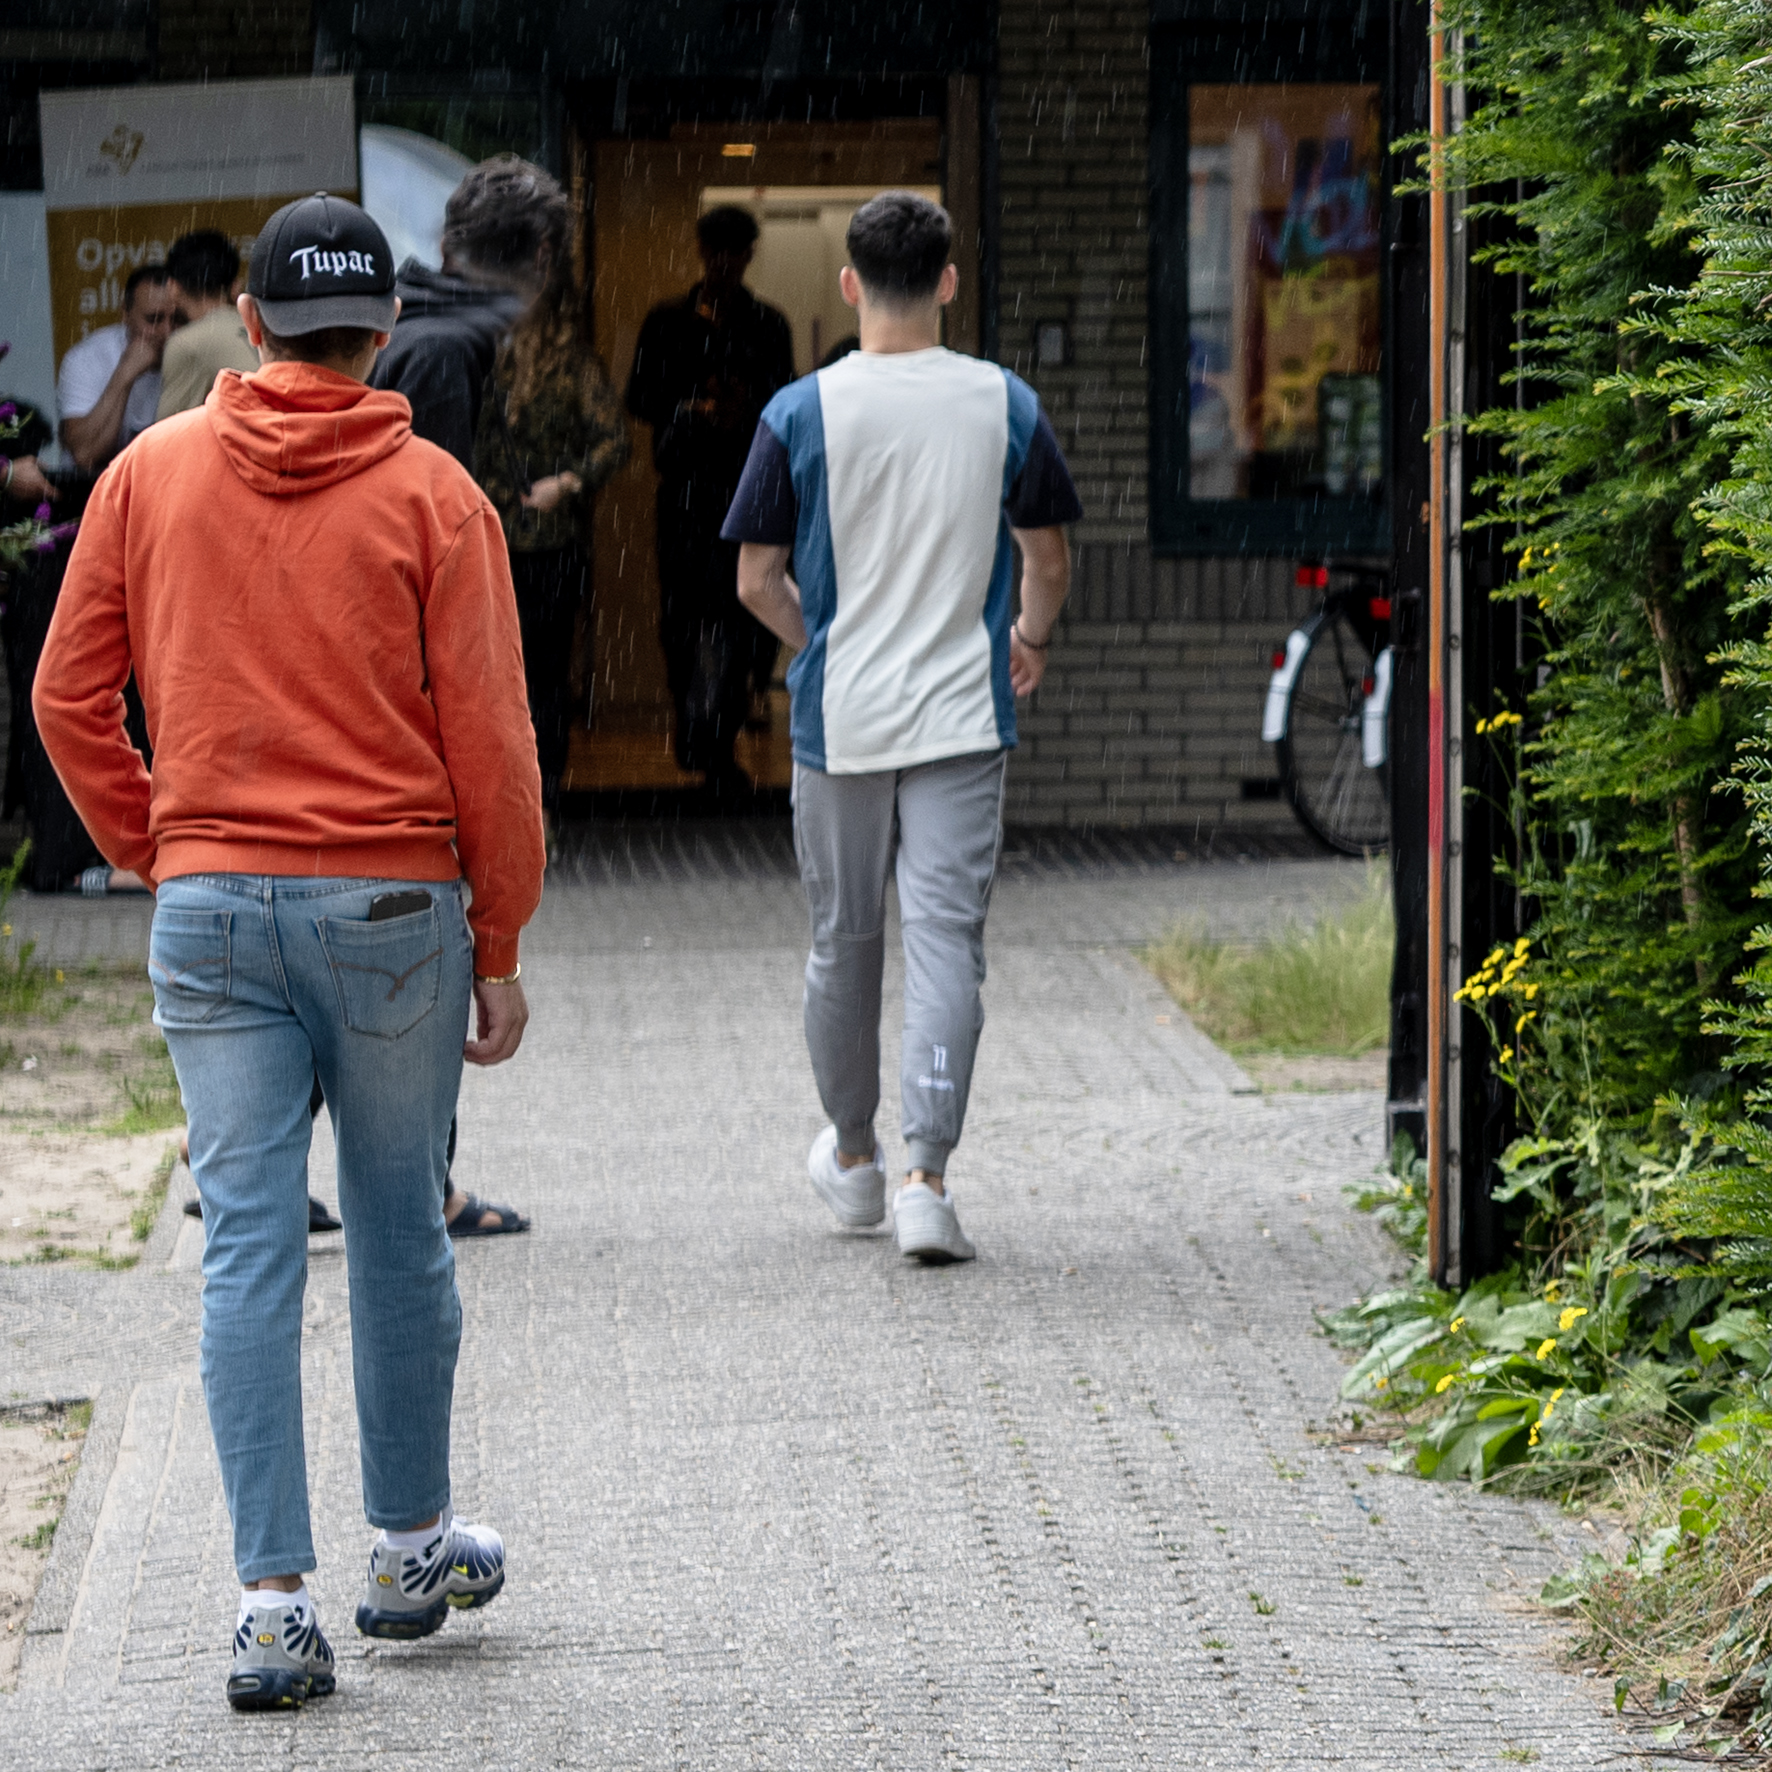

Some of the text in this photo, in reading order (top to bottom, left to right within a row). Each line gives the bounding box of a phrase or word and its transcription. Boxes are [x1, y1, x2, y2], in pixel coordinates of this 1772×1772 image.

[77, 238, 167, 276] Opva
[289, 244, 375, 281] Tupac
[79, 276, 124, 315] all
